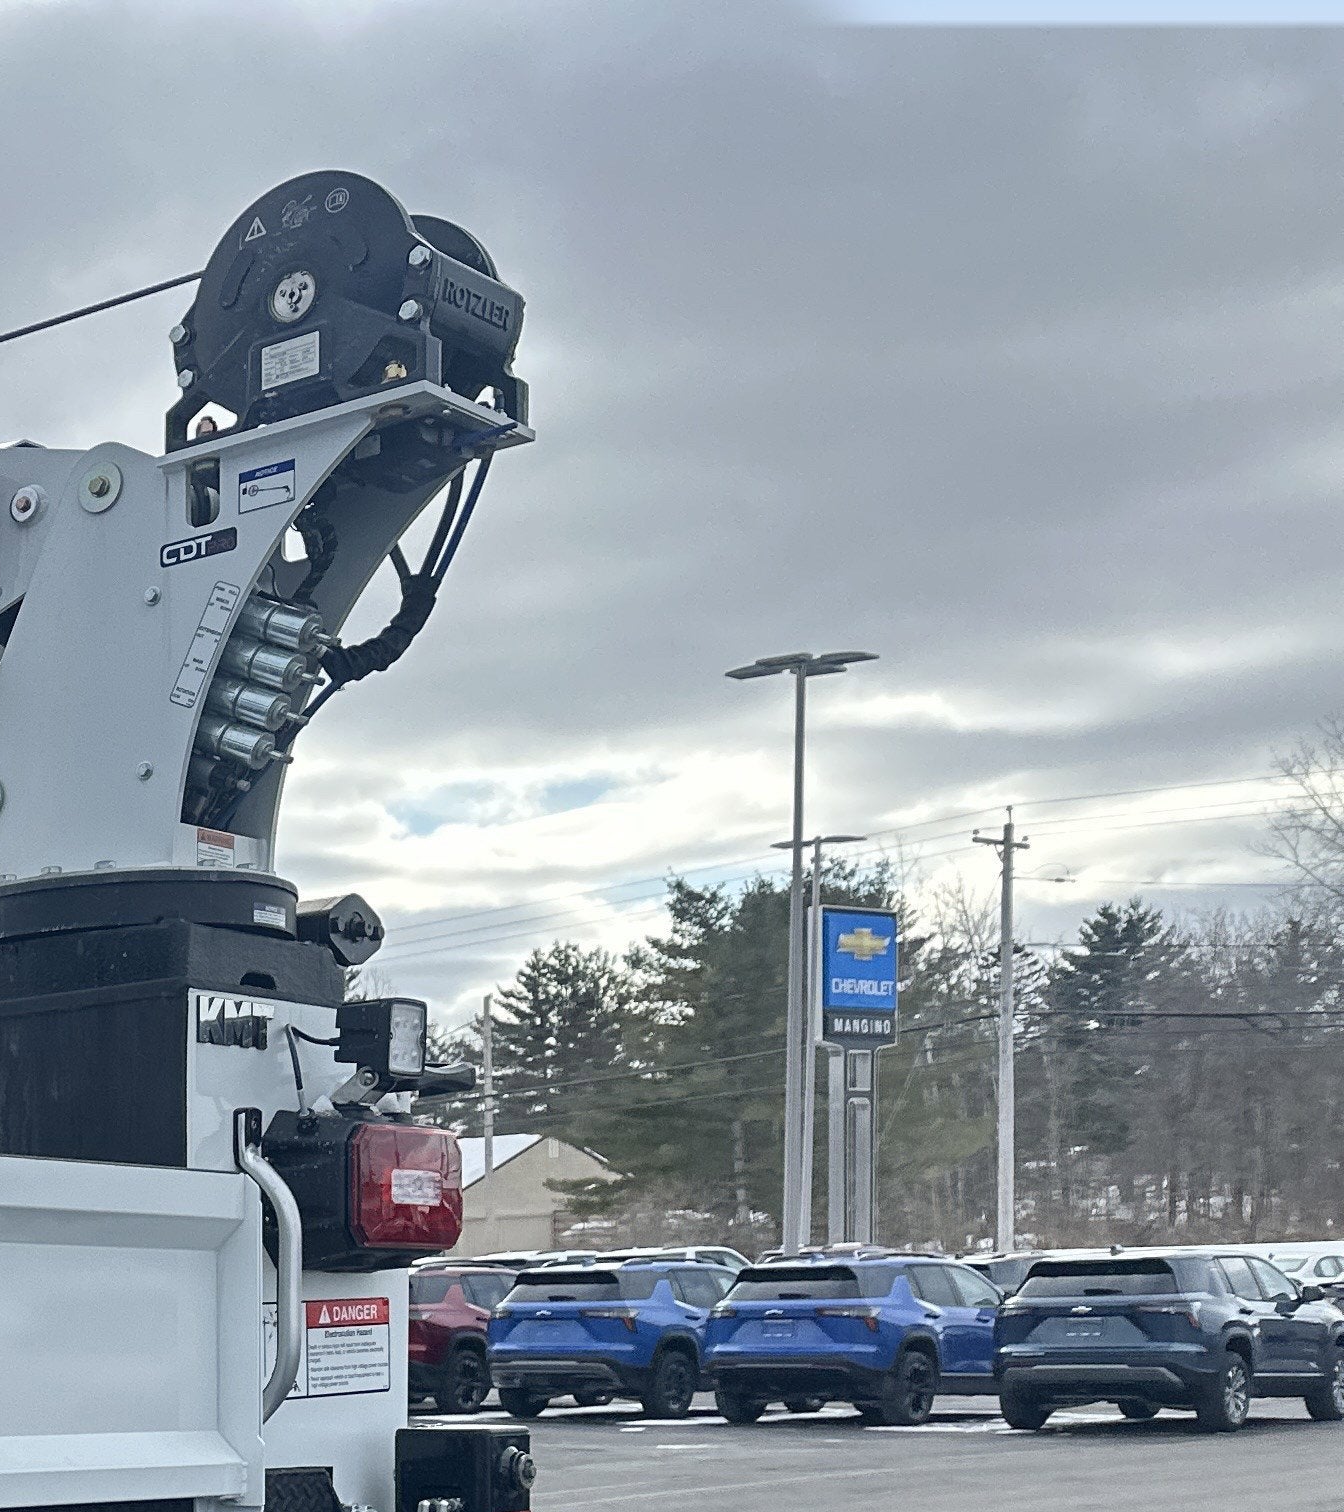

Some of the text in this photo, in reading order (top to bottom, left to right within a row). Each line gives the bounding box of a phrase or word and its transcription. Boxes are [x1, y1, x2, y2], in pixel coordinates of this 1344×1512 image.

[442, 277, 510, 332] ROTZLER
[832, 977, 895, 996] CHEVROLET
[833, 1017, 891, 1035] MANGINO
[332, 1303, 378, 1322] DANGER
